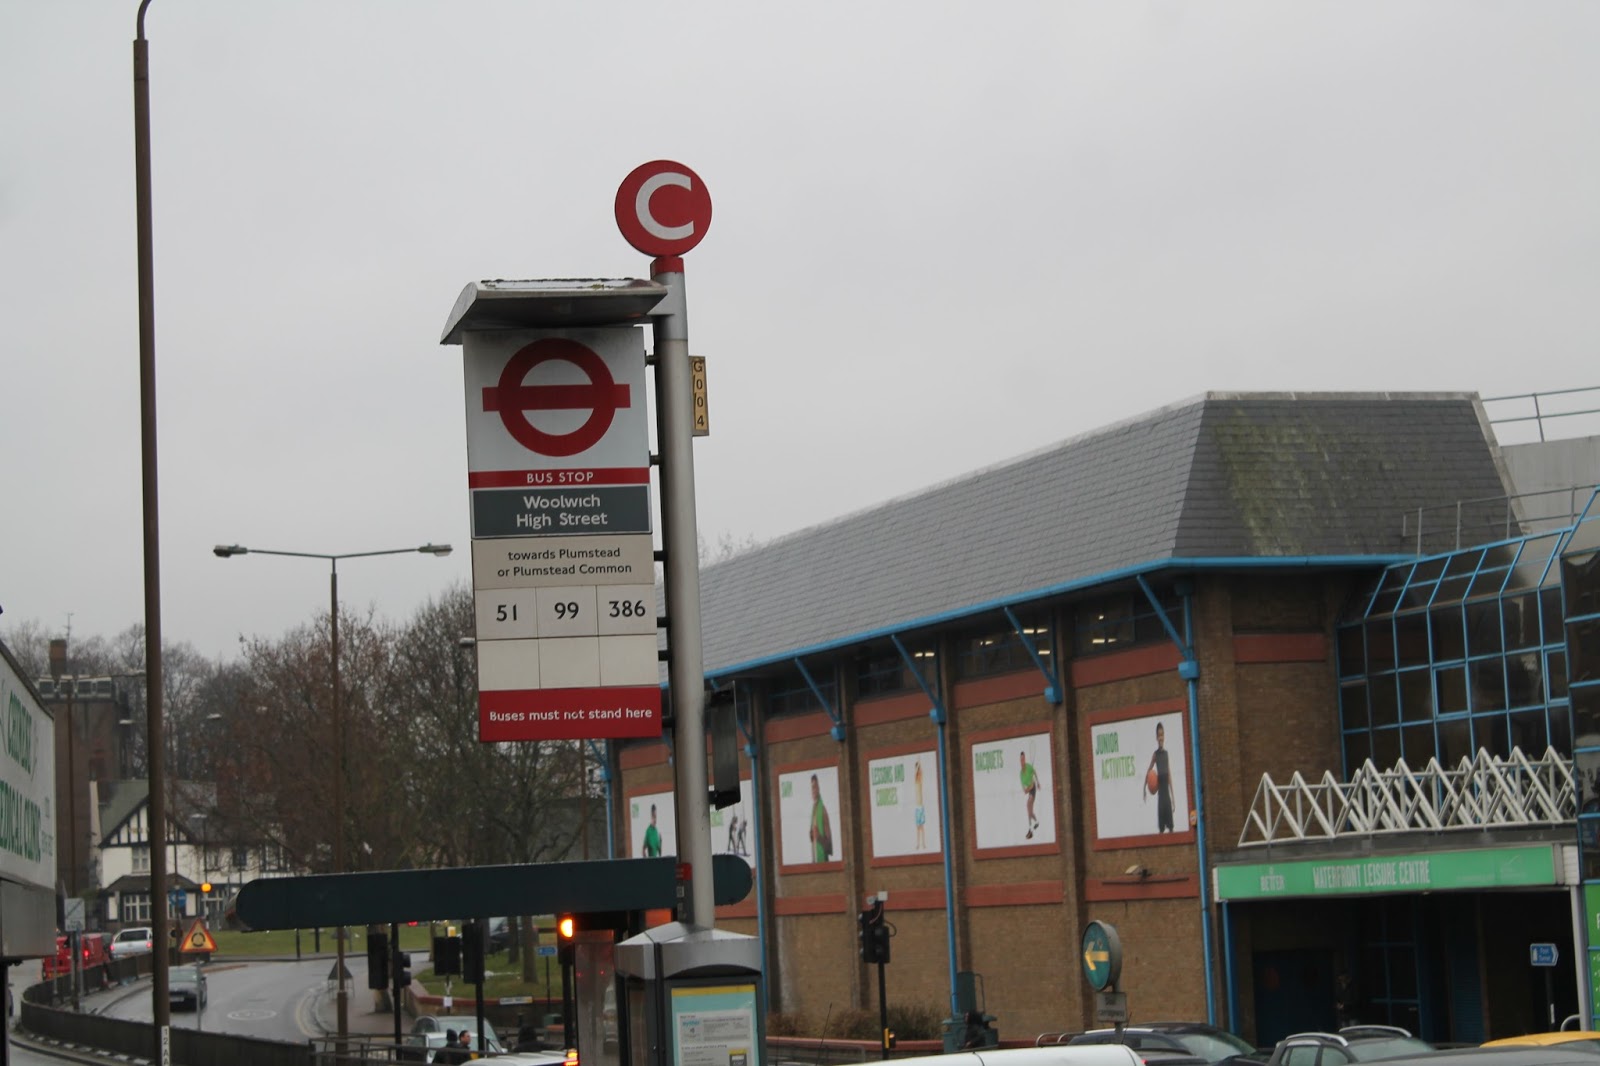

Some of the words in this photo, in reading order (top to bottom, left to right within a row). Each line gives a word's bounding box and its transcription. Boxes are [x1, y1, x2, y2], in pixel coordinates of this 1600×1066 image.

[635, 171, 695, 241] C
[526, 473, 553, 484] BUS
[558, 472, 594, 483] STOP
[523, 494, 601, 510] Woolwich
[516, 514, 552, 530] High
[559, 512, 608, 526] Street
[508, 550, 556, 561] towards
[559, 547, 621, 559] Plumstead
[497, 569, 510, 577] or
[513, 565, 576, 577] Plumstead
[579, 563, 632, 574] Common
[496, 604, 518, 622] 51
[554, 602, 580, 620] 99
[608, 600, 646, 618] 386
[489, 711, 525, 721] Buses
[529, 710, 560, 720] must
[564, 710, 585, 720] not
[588, 708, 622, 719] stand
[625, 708, 653, 718] here
[1096, 732, 1119, 754] JUNIOR
[1102, 756, 1135, 779] ACTIVITIES
[1312, 865, 1361, 888] WATERFRONT
[1364, 863, 1397, 886] LEISURE
[1399, 860, 1431, 884] CENTRE
